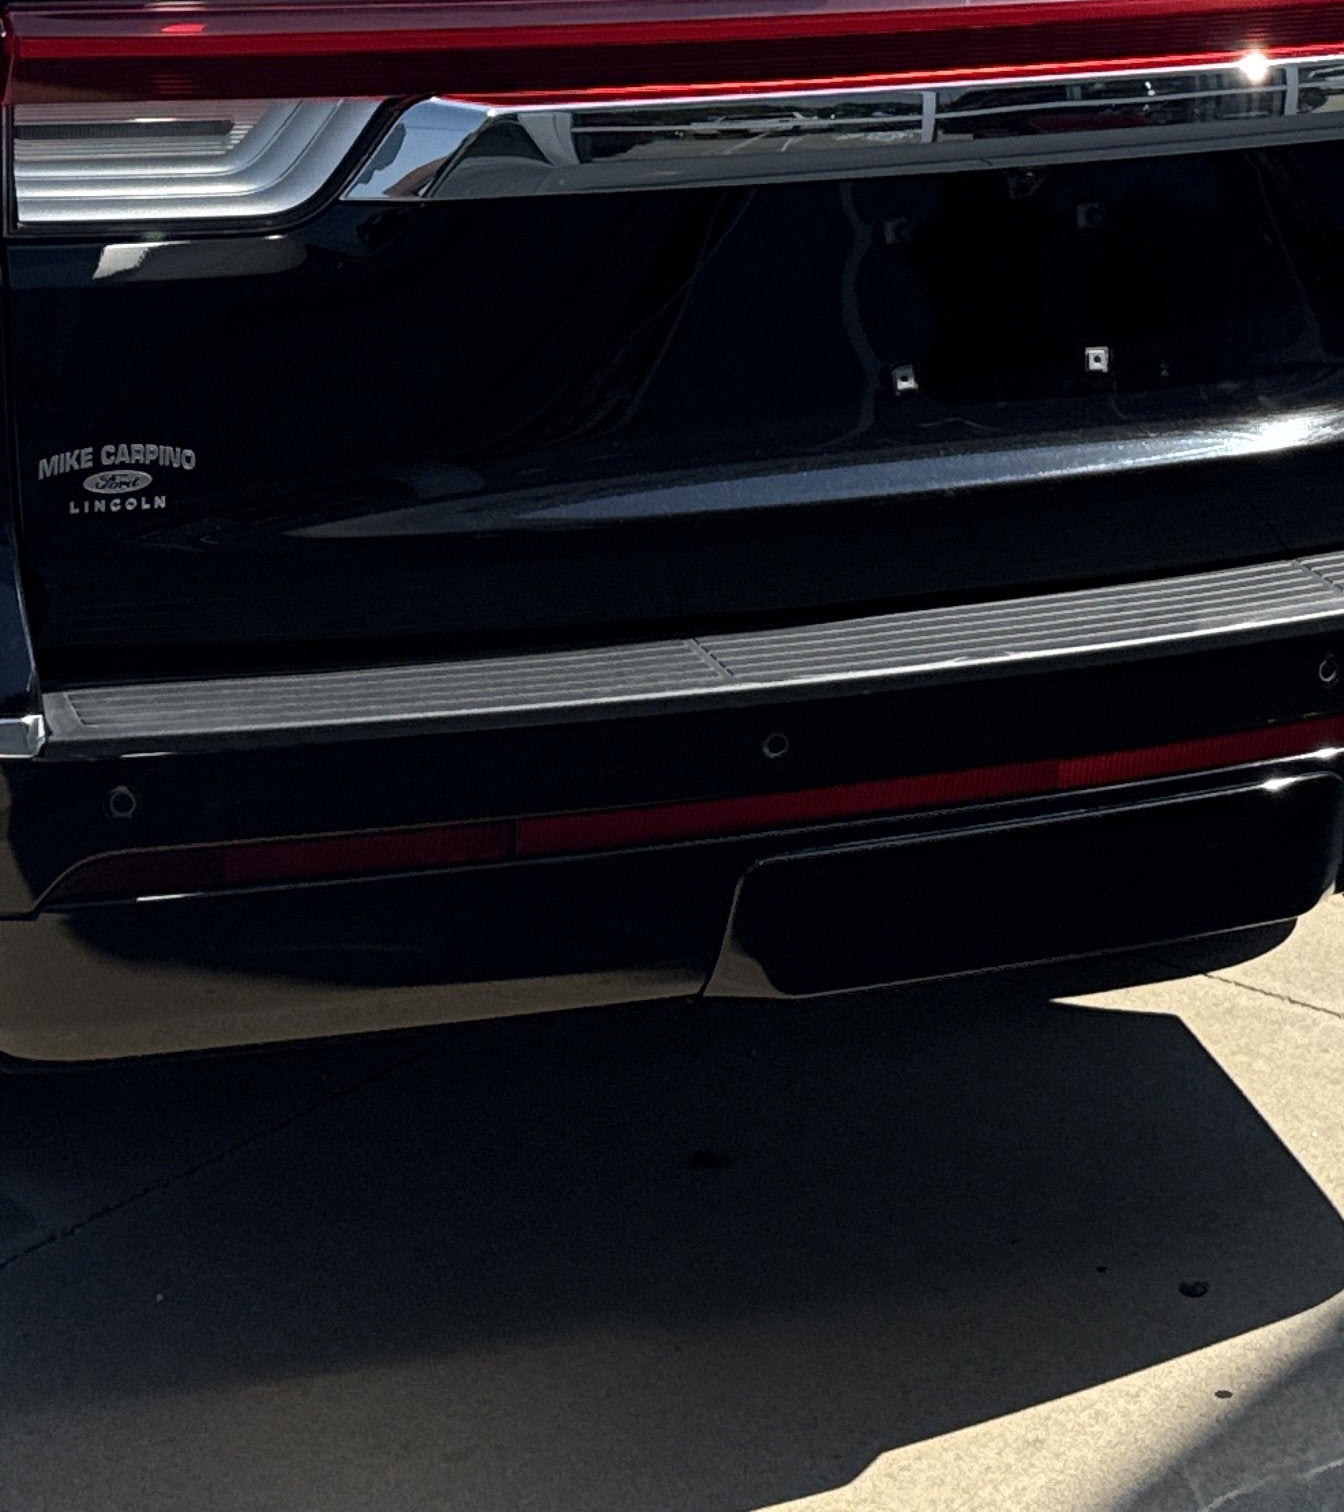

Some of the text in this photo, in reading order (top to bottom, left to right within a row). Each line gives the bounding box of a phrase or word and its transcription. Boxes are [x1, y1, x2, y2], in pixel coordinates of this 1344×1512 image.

[38, 443, 196, 480] MIKE CARPINO
[69, 495, 167, 514] LINCOLN
